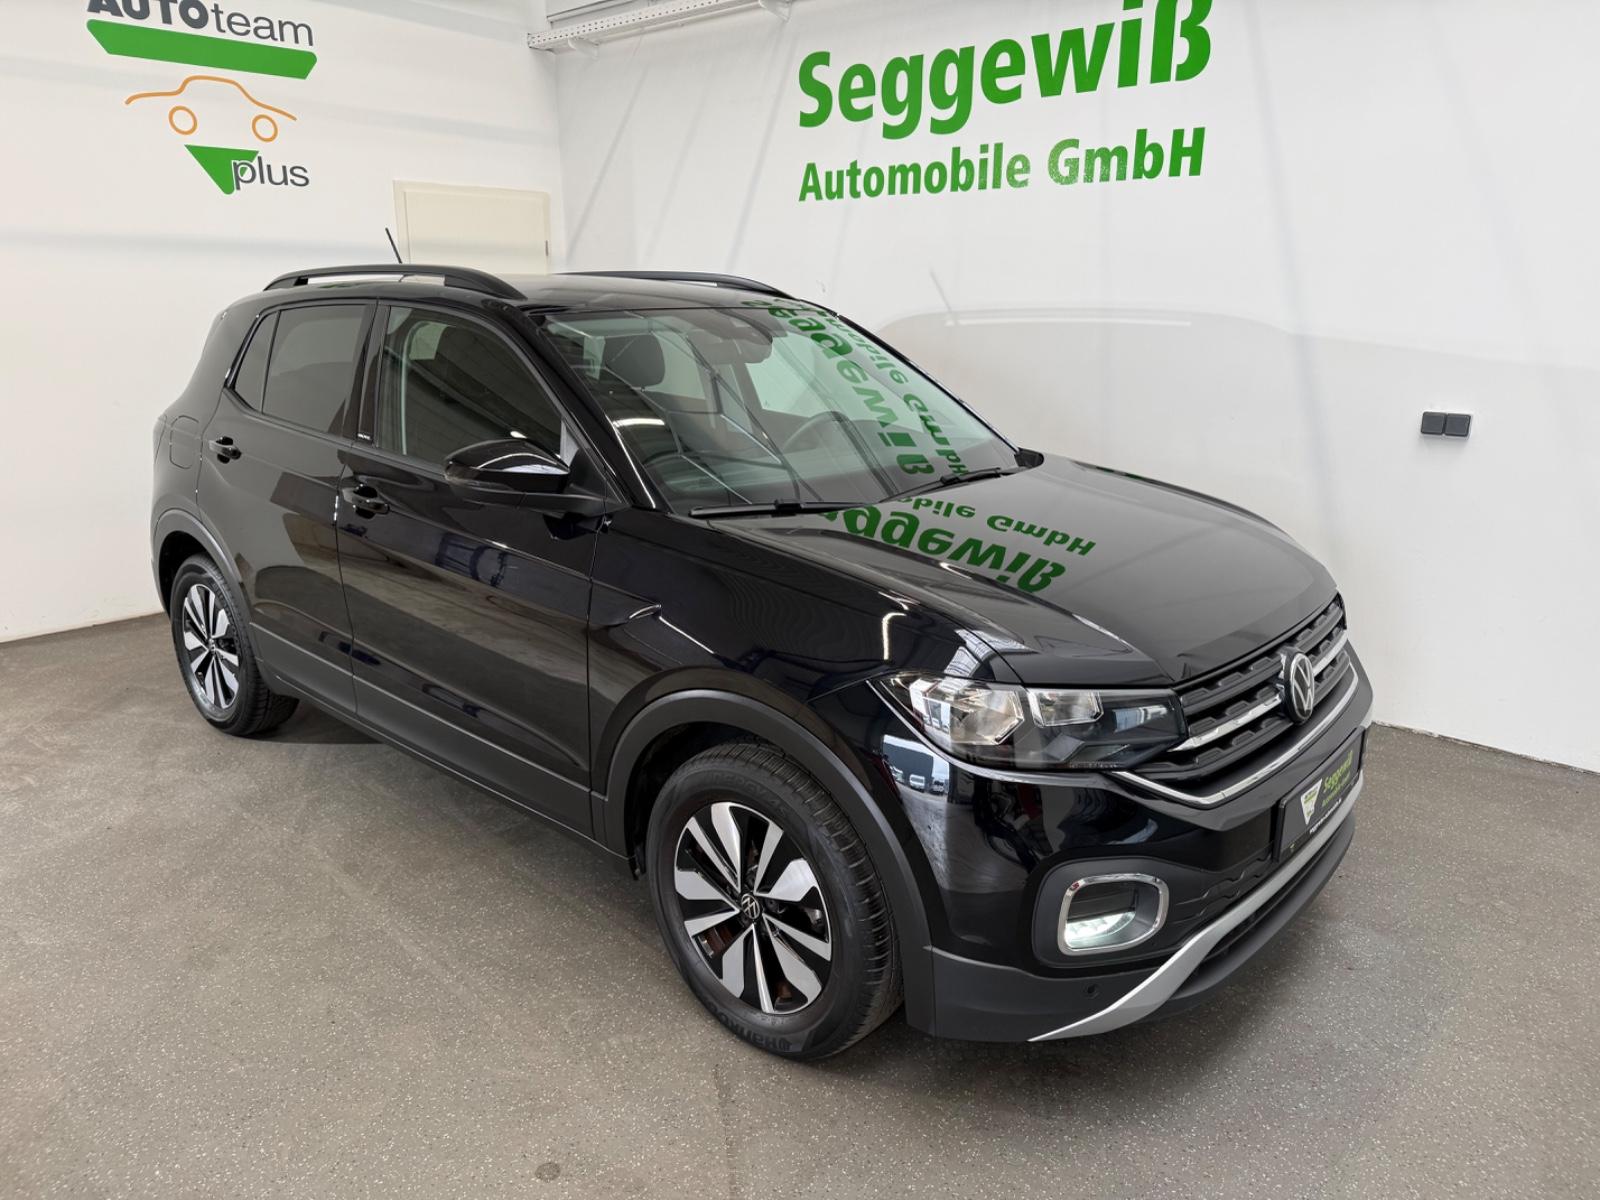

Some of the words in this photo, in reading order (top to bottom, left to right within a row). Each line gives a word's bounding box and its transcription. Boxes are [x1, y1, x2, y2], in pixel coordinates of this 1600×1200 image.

[798, 0, 1213, 139] Seggewiß
[232, 155, 310, 190] plus
[798, 142, 1031, 201] Automobile
[1048, 126, 1206, 185] GmbH
